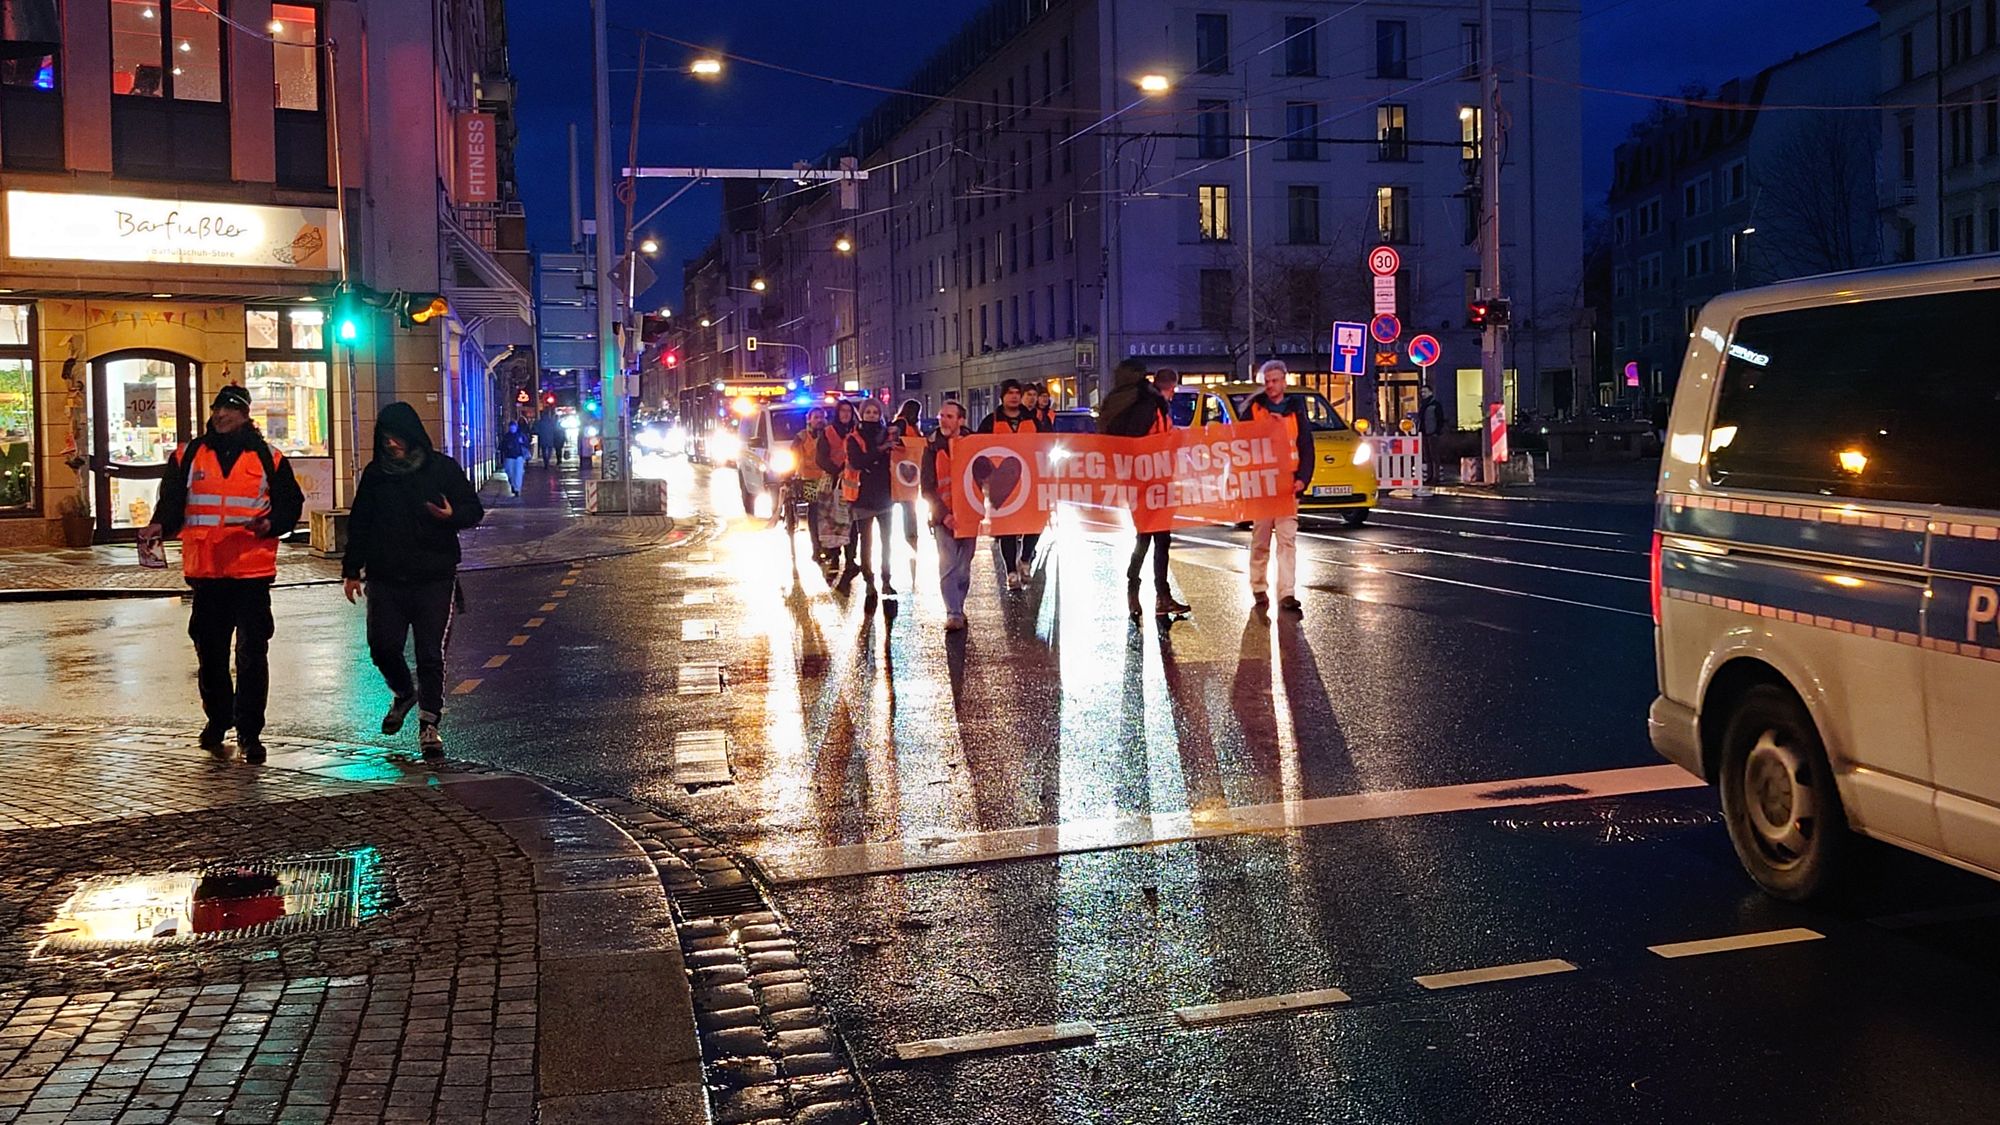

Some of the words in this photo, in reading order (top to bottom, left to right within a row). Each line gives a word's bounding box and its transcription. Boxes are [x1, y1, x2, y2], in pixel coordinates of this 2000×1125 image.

[468, 120, 486, 195] FITNESS
[1376, 255, 1392, 268] 30
[1130, 343, 1201, 355] BÄCKEREI
[126, 399, 156, 412] -10%
[1035, 451, 1106, 480] WEG
[1113, 450, 1172, 482] VON
[1176, 437, 1278, 474] FOSSIL
[1037, 483, 1092, 512] HIN
[1100, 484, 1138, 513] ZU
[1146, 468, 1279, 511] GERECHT
[1967, 585, 2000, 641] P
